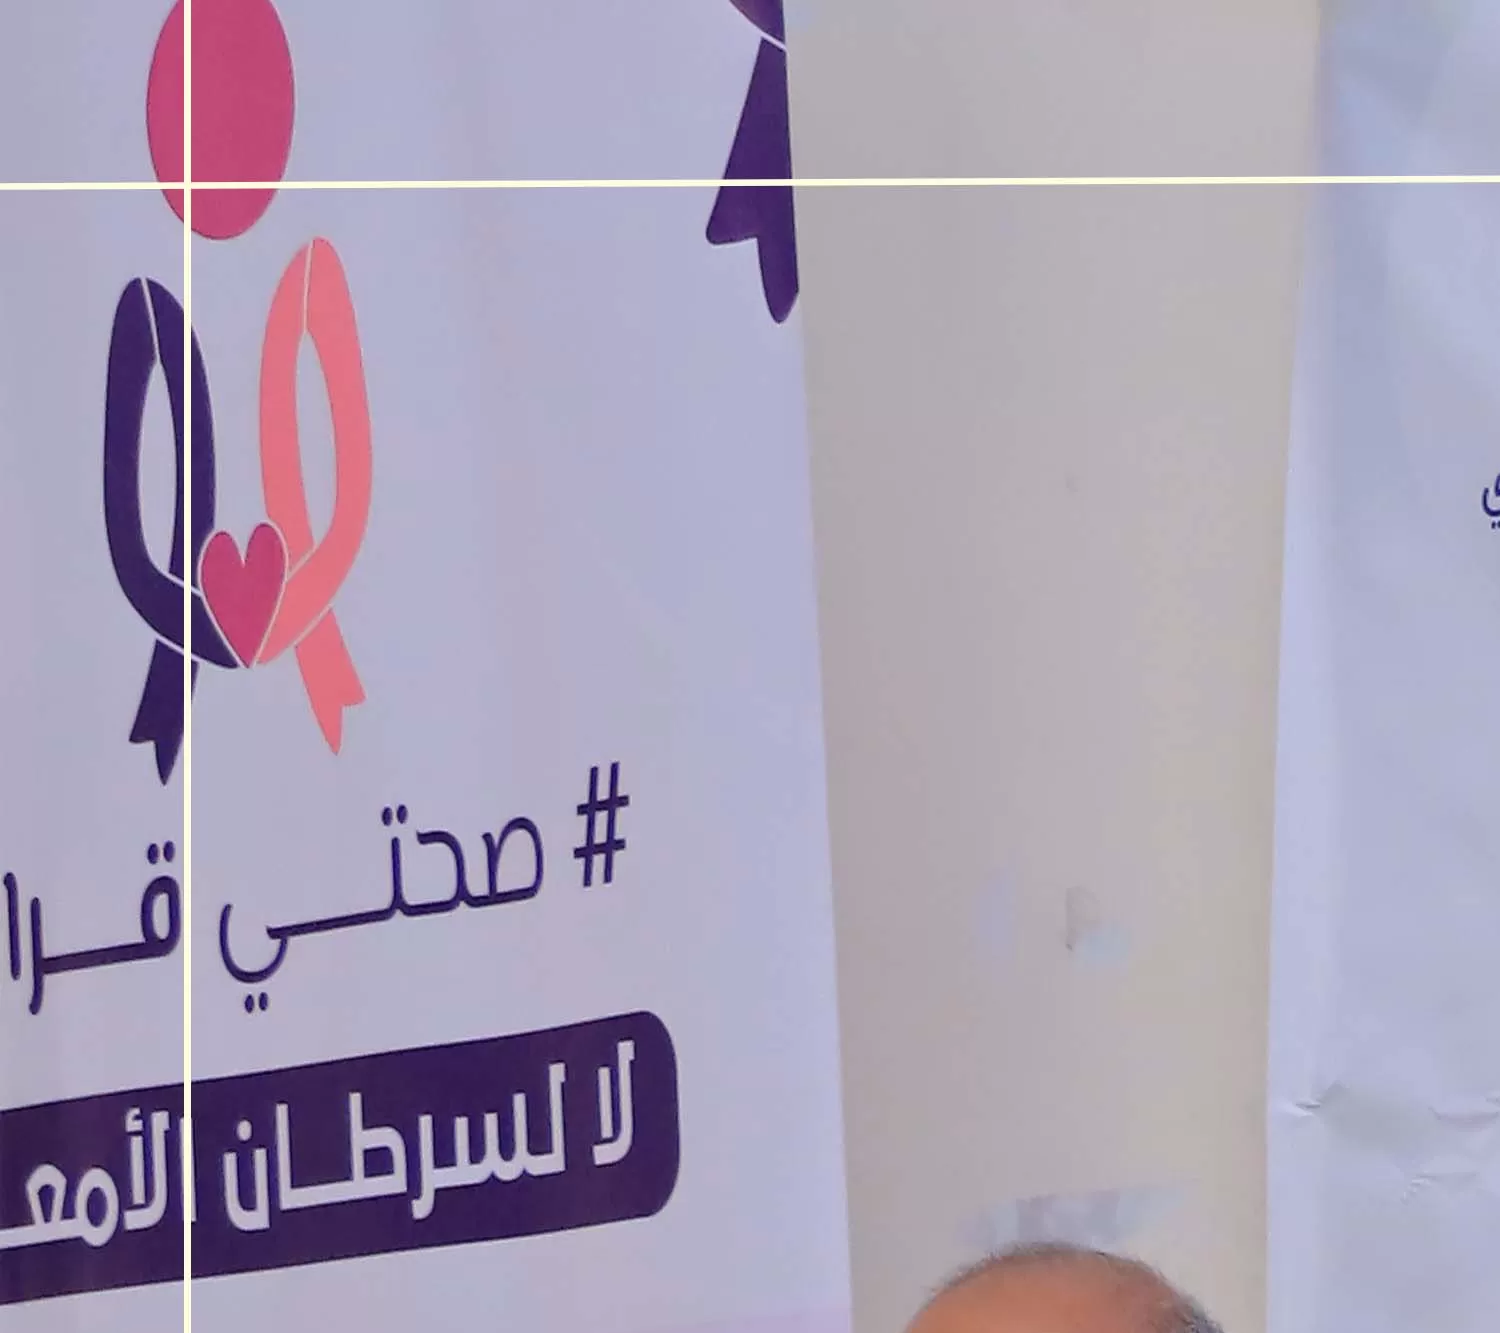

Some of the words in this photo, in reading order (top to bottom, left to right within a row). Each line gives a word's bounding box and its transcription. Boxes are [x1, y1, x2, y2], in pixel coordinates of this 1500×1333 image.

[218, 804, 545, 1013] صحتي
[222, 1061, 568, 1233] لسرطان
[592, 1039, 636, 1168] لا
